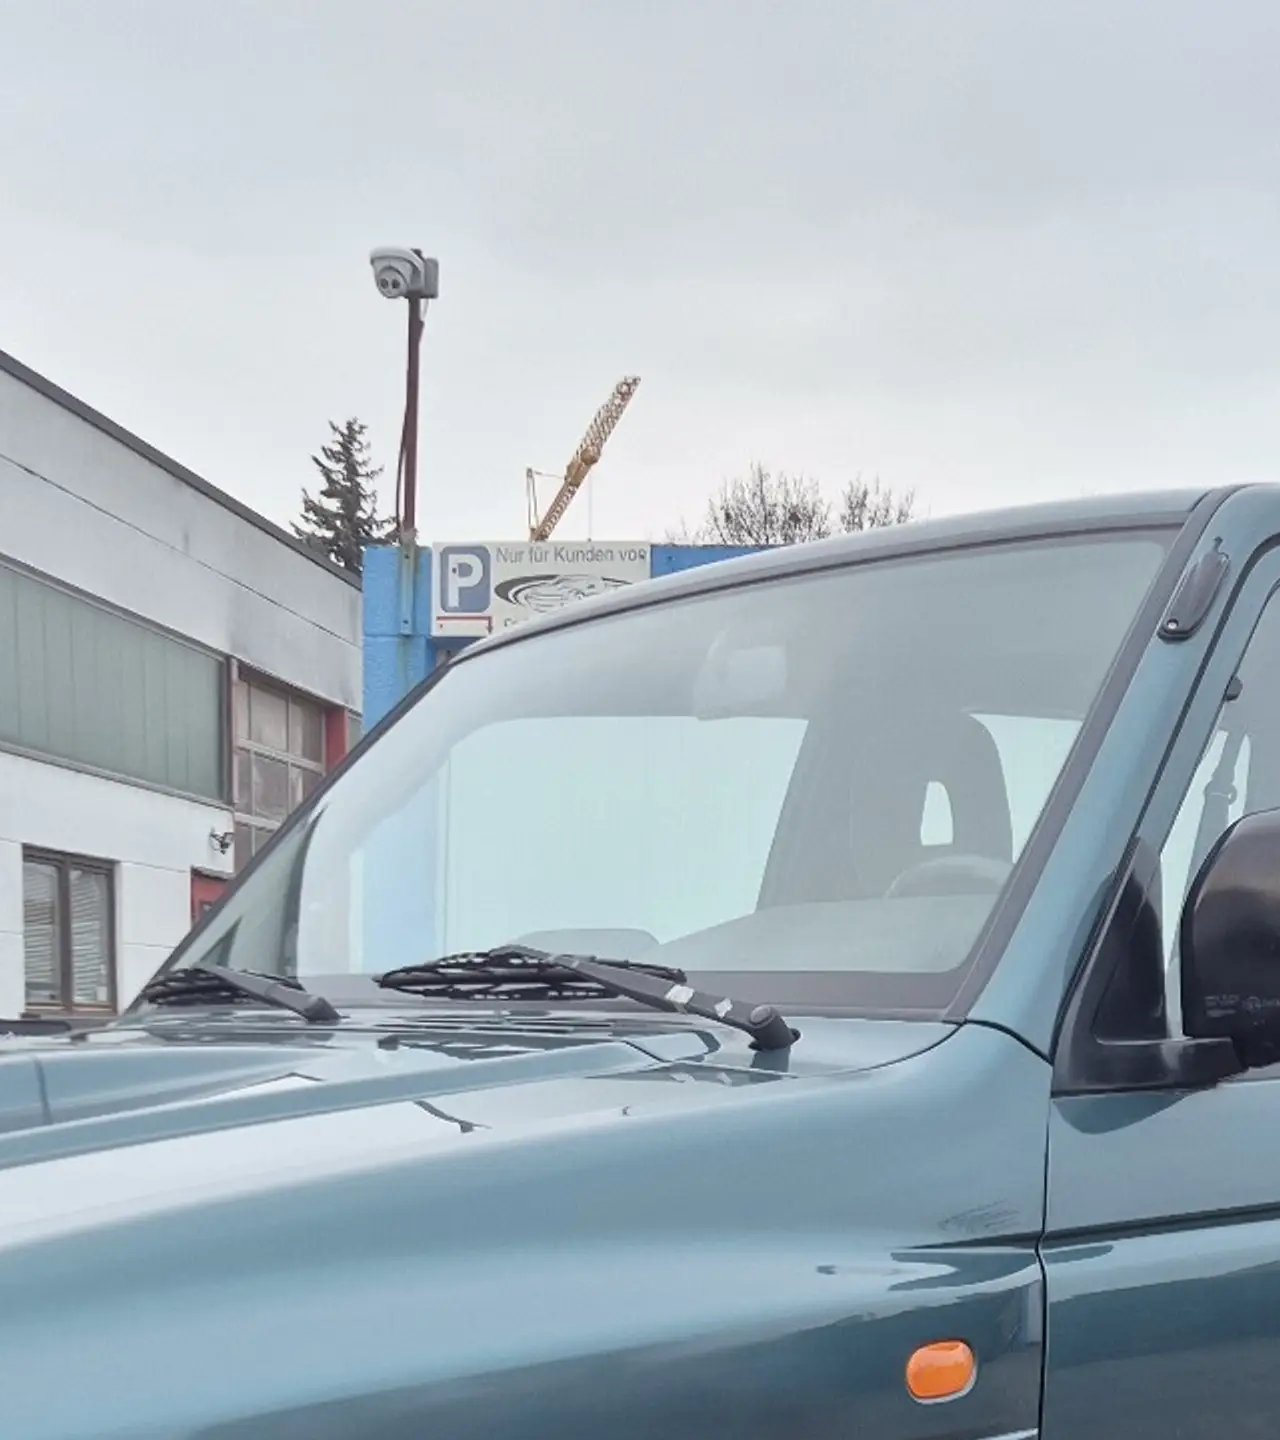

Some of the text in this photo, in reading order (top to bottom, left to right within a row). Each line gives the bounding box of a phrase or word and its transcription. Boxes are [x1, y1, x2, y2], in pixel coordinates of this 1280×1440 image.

[495, 548, 522, 562] Nur
[529, 547, 549, 563] für
[554, 546, 614, 562] Kunden
[447, 554, 484, 608] P
